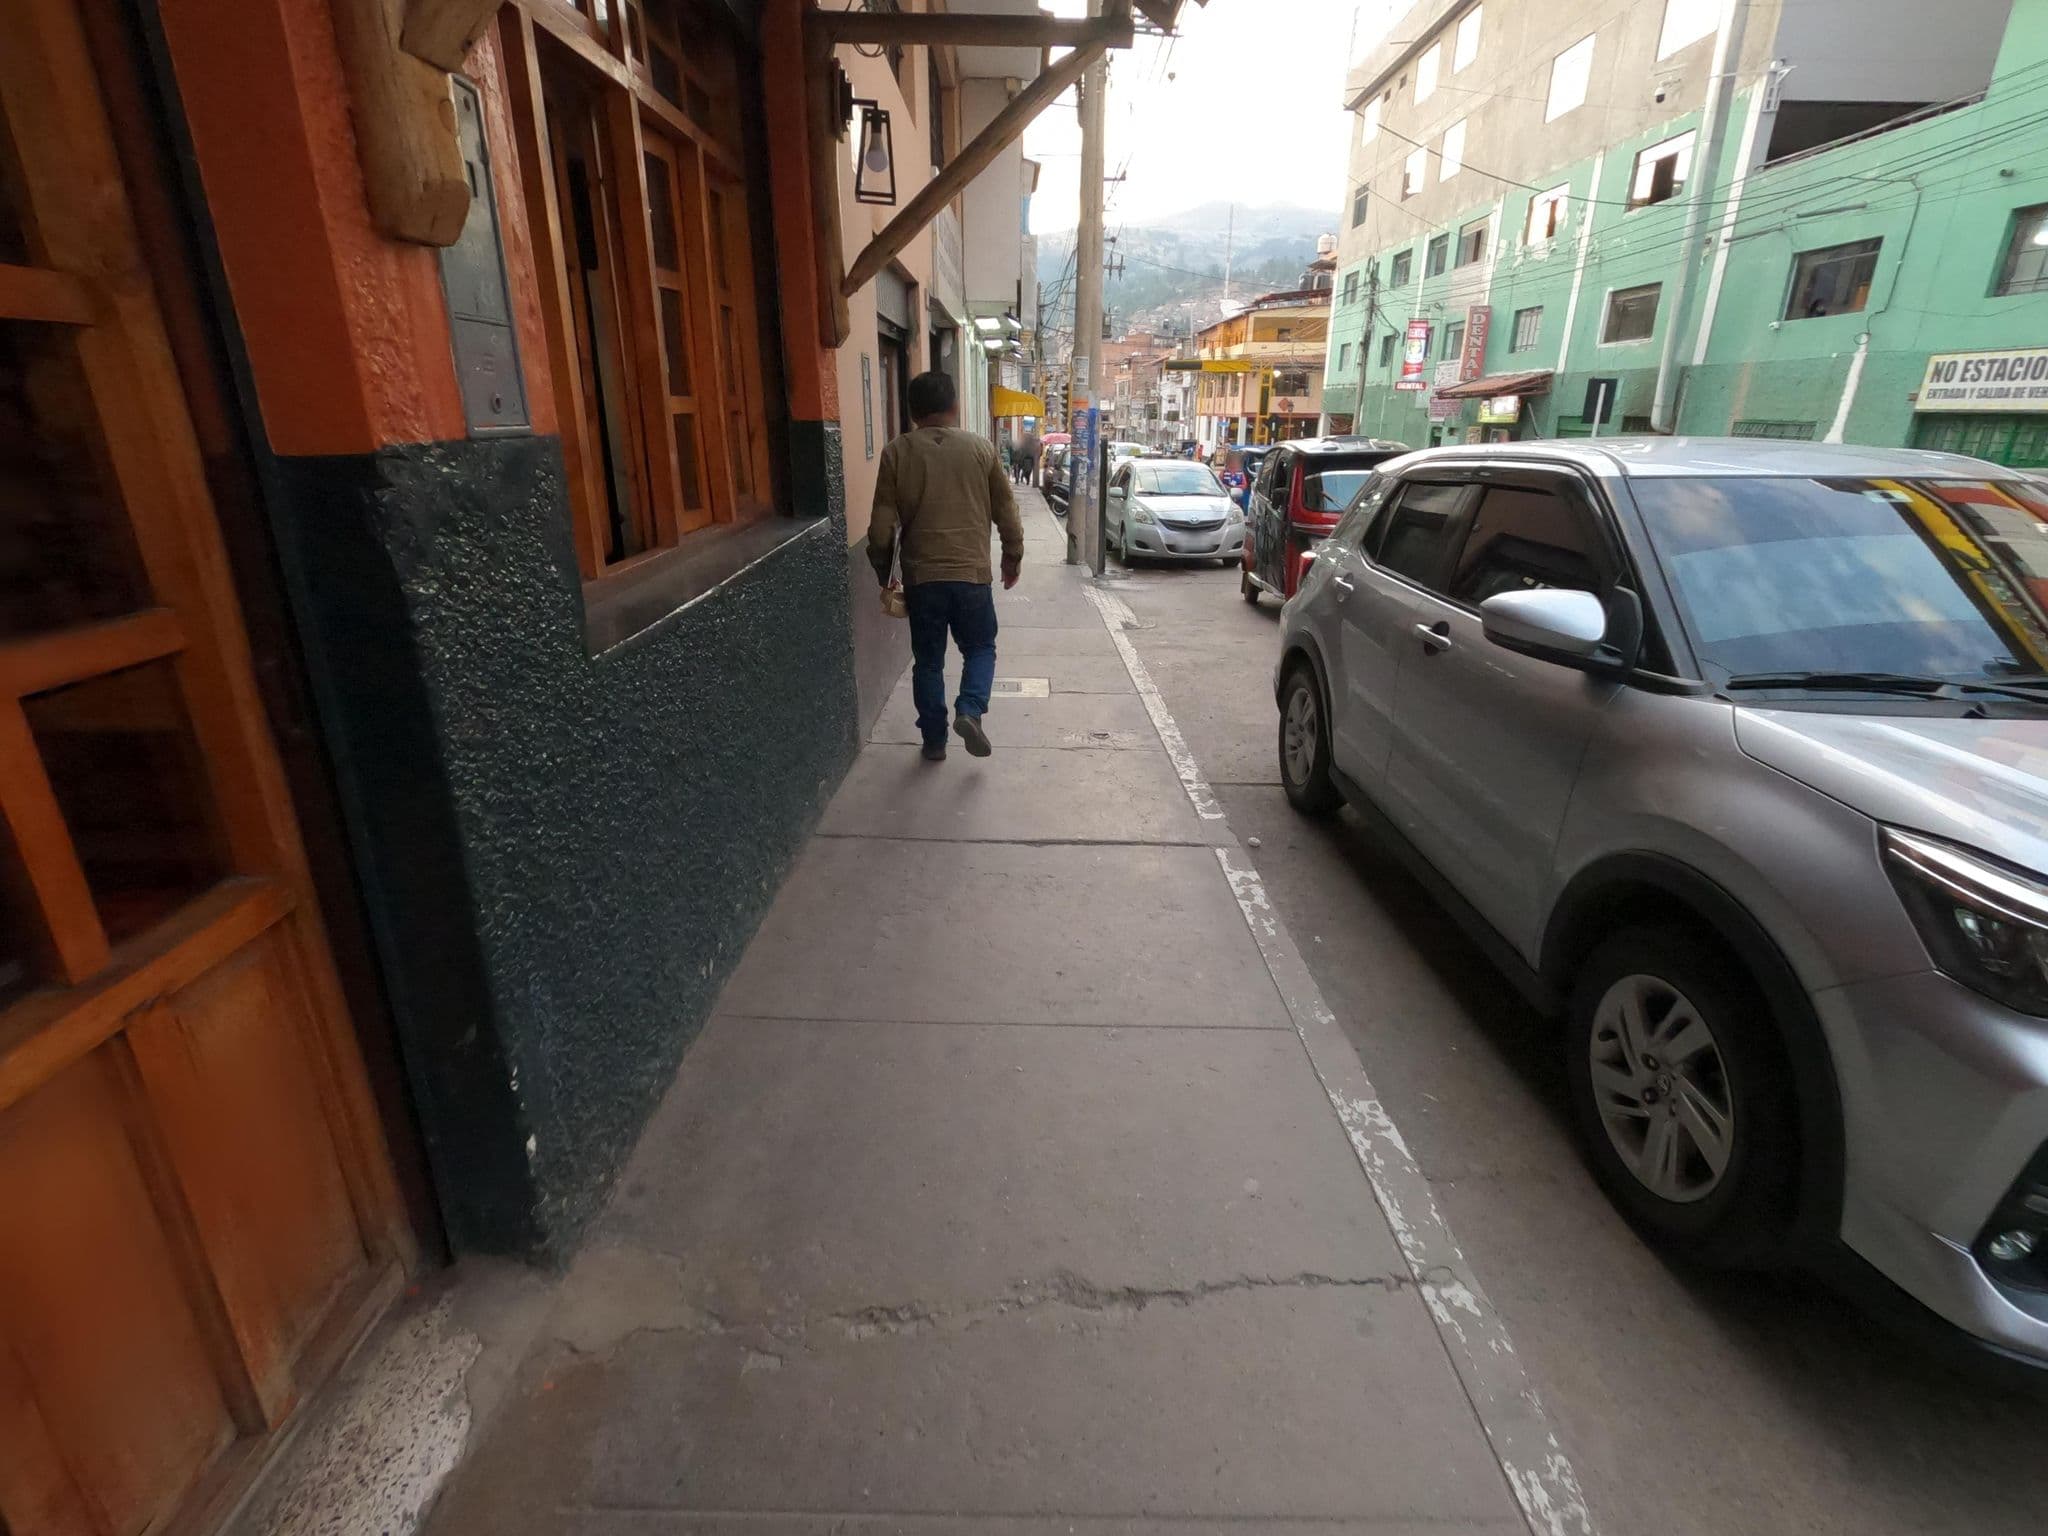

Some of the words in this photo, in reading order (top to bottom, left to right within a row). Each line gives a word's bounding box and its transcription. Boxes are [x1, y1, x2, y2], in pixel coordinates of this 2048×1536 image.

[1464, 313, 1486, 380] DENTAL
[1930, 360, 1958, 383] NO
[1960, 356, 2048, 382] ESTACIO
[1396, 382, 1425, 390] DENTAL
[1927, 388, 1967, 399] ENTRADA
[1968, 388, 1976, 399] Y
[1976, 387, 2011, 399] SALIDA
[2011, 387, 2028, 398] DE
